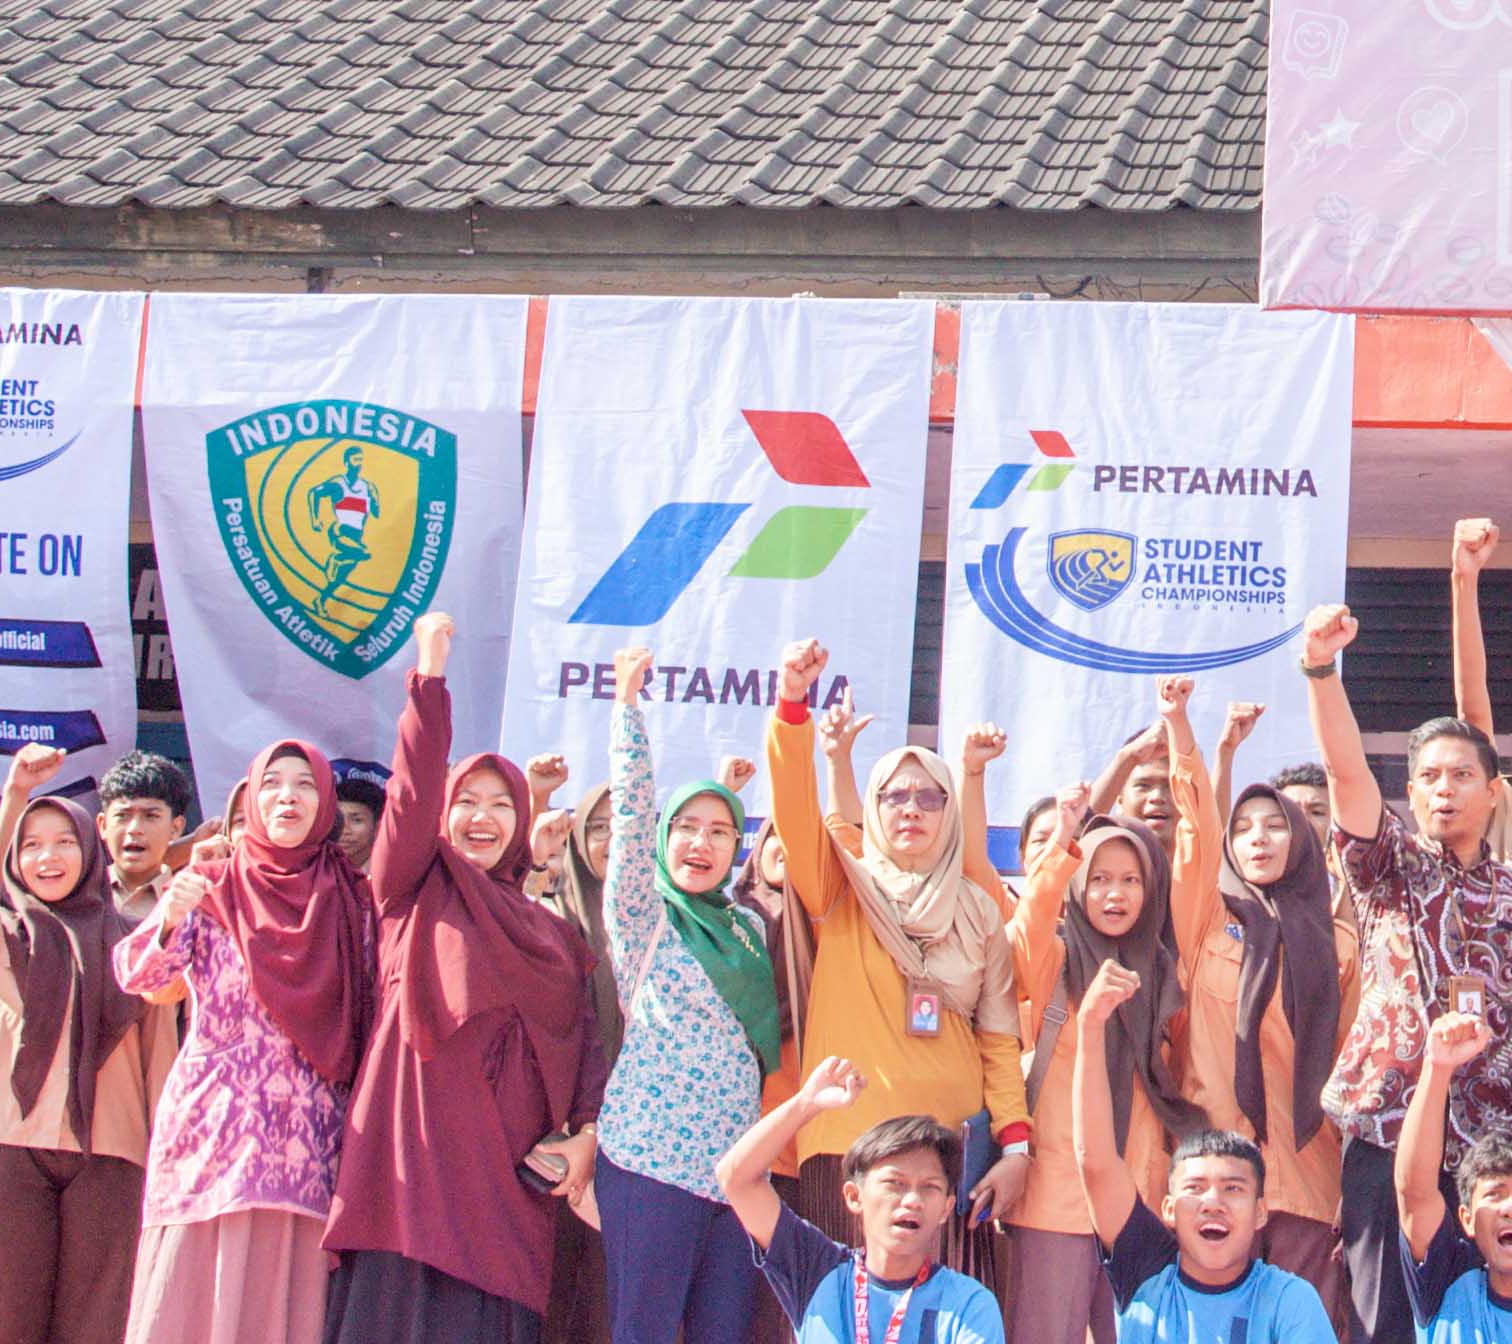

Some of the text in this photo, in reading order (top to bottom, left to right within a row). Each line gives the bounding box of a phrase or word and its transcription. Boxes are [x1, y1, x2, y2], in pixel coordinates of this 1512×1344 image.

[225, 405, 439, 457] INDONESIA
[1093, 464, 1319, 498] PERTAMINA
[38, 533, 83, 577] ON
[1144, 538, 1263, 563] STUDENT
[222, 496, 341, 661] Persatuan Atletik
[352, 499, 447, 662] Seluruh Indonesia
[1141, 587, 1286, 605] CHAMPIONSHIPS
[1142, 563, 1287, 588] ATHLETICS
[558, 661, 857, 713] PETAMIA
